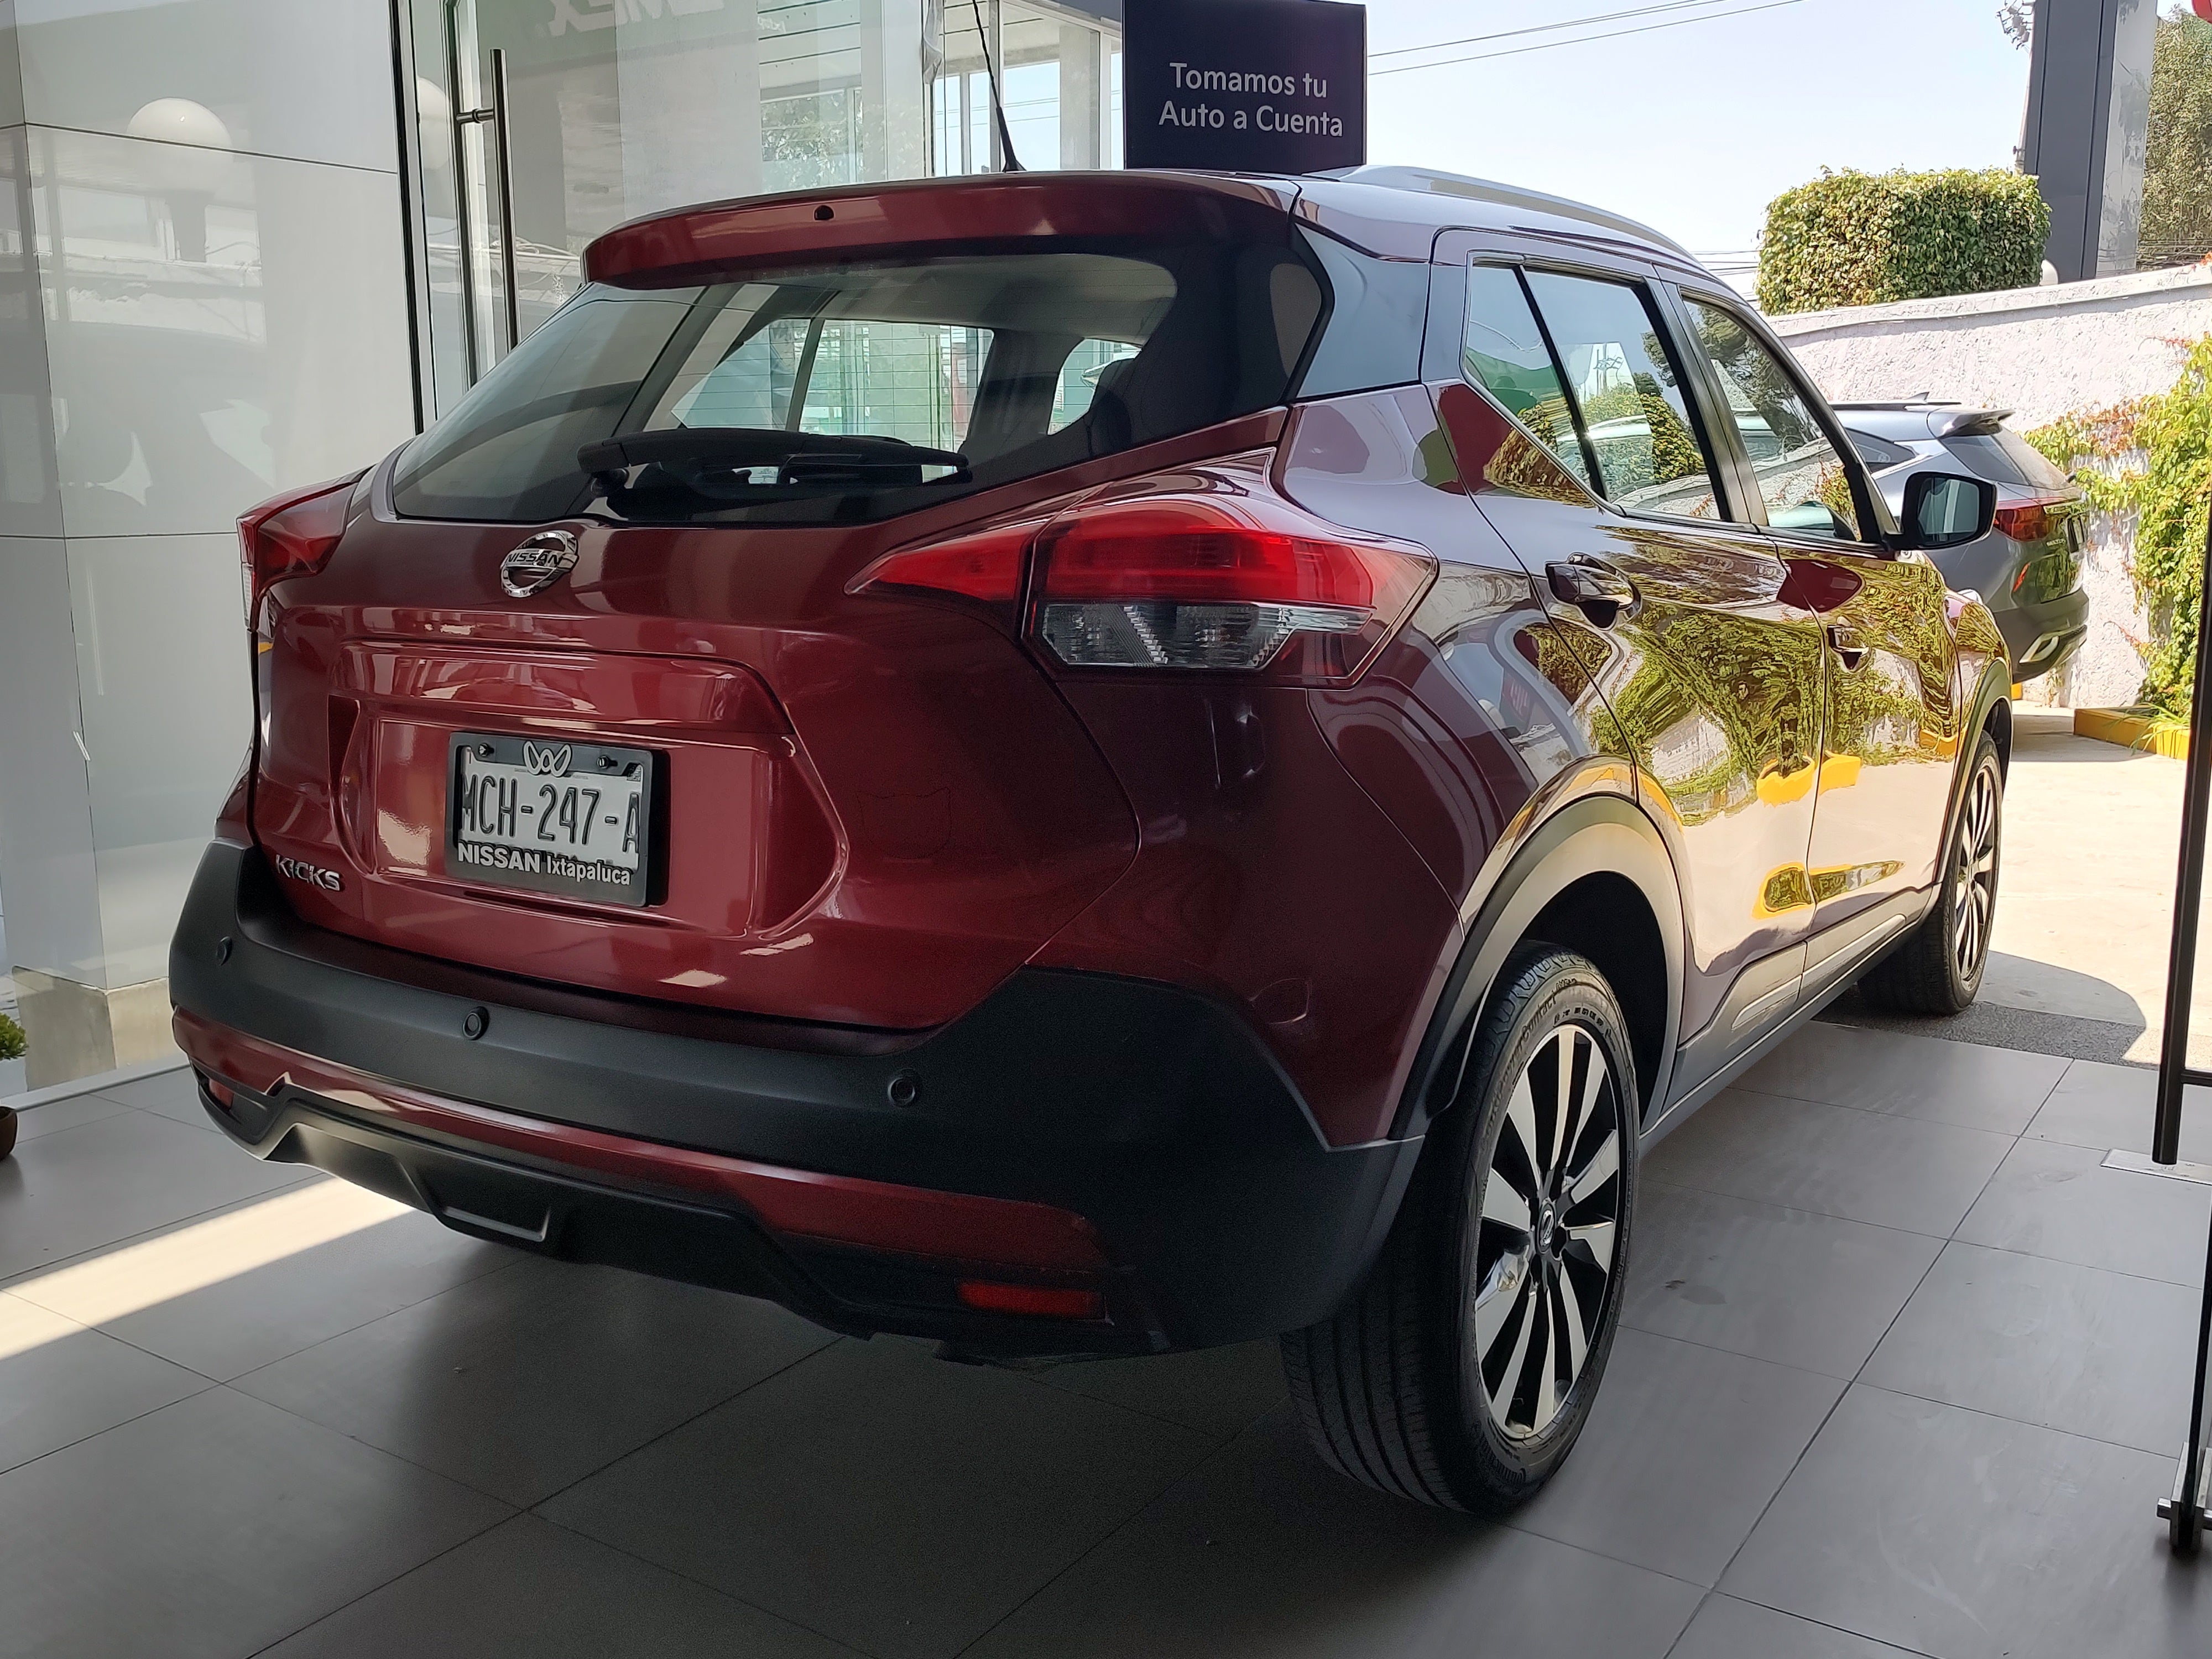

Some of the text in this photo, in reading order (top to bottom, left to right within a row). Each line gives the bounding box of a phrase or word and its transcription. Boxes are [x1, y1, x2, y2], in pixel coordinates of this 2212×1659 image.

[1169, 62, 1327, 98] Tomamos tu
[1159, 100, 1343, 137] Auto a Cuenta
[507, 552, 562, 565] NISSAN
[461, 774, 640, 854] MCH-247-A
[276, 854, 340, 891] KICKS
[458, 842, 632, 885] NISSAN Ixtapaluca
